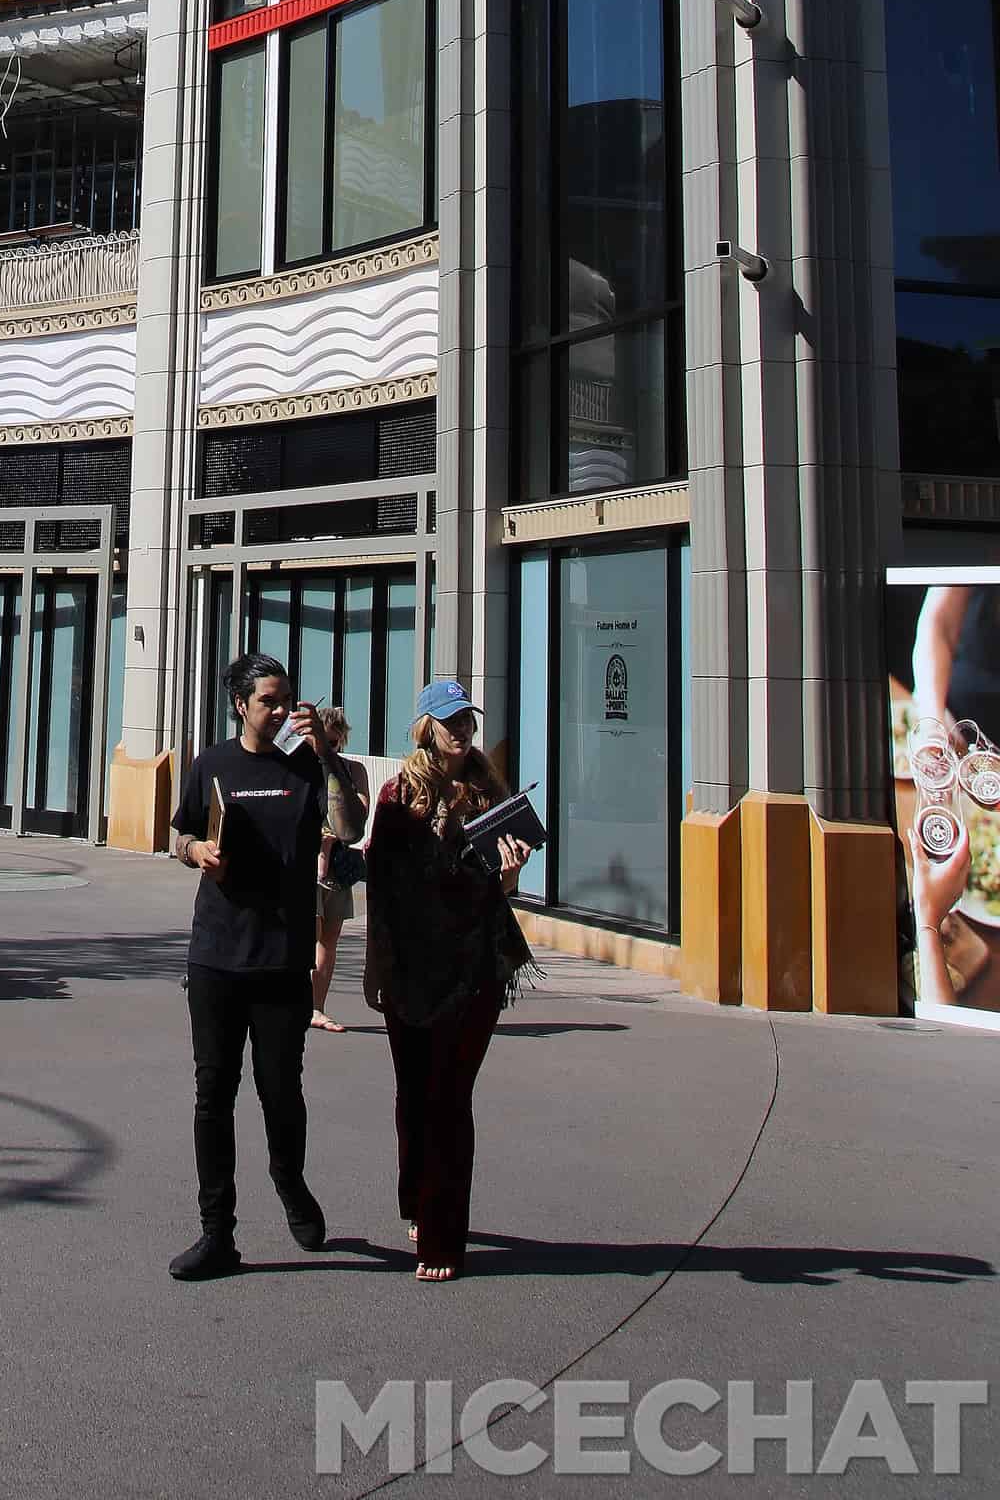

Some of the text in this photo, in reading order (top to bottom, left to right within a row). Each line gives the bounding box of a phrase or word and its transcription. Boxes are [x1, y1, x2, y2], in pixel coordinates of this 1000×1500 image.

[596, 620, 614, 630] Future
[615, 619, 630, 630] Home
[605, 690, 628, 701] BALLAST
